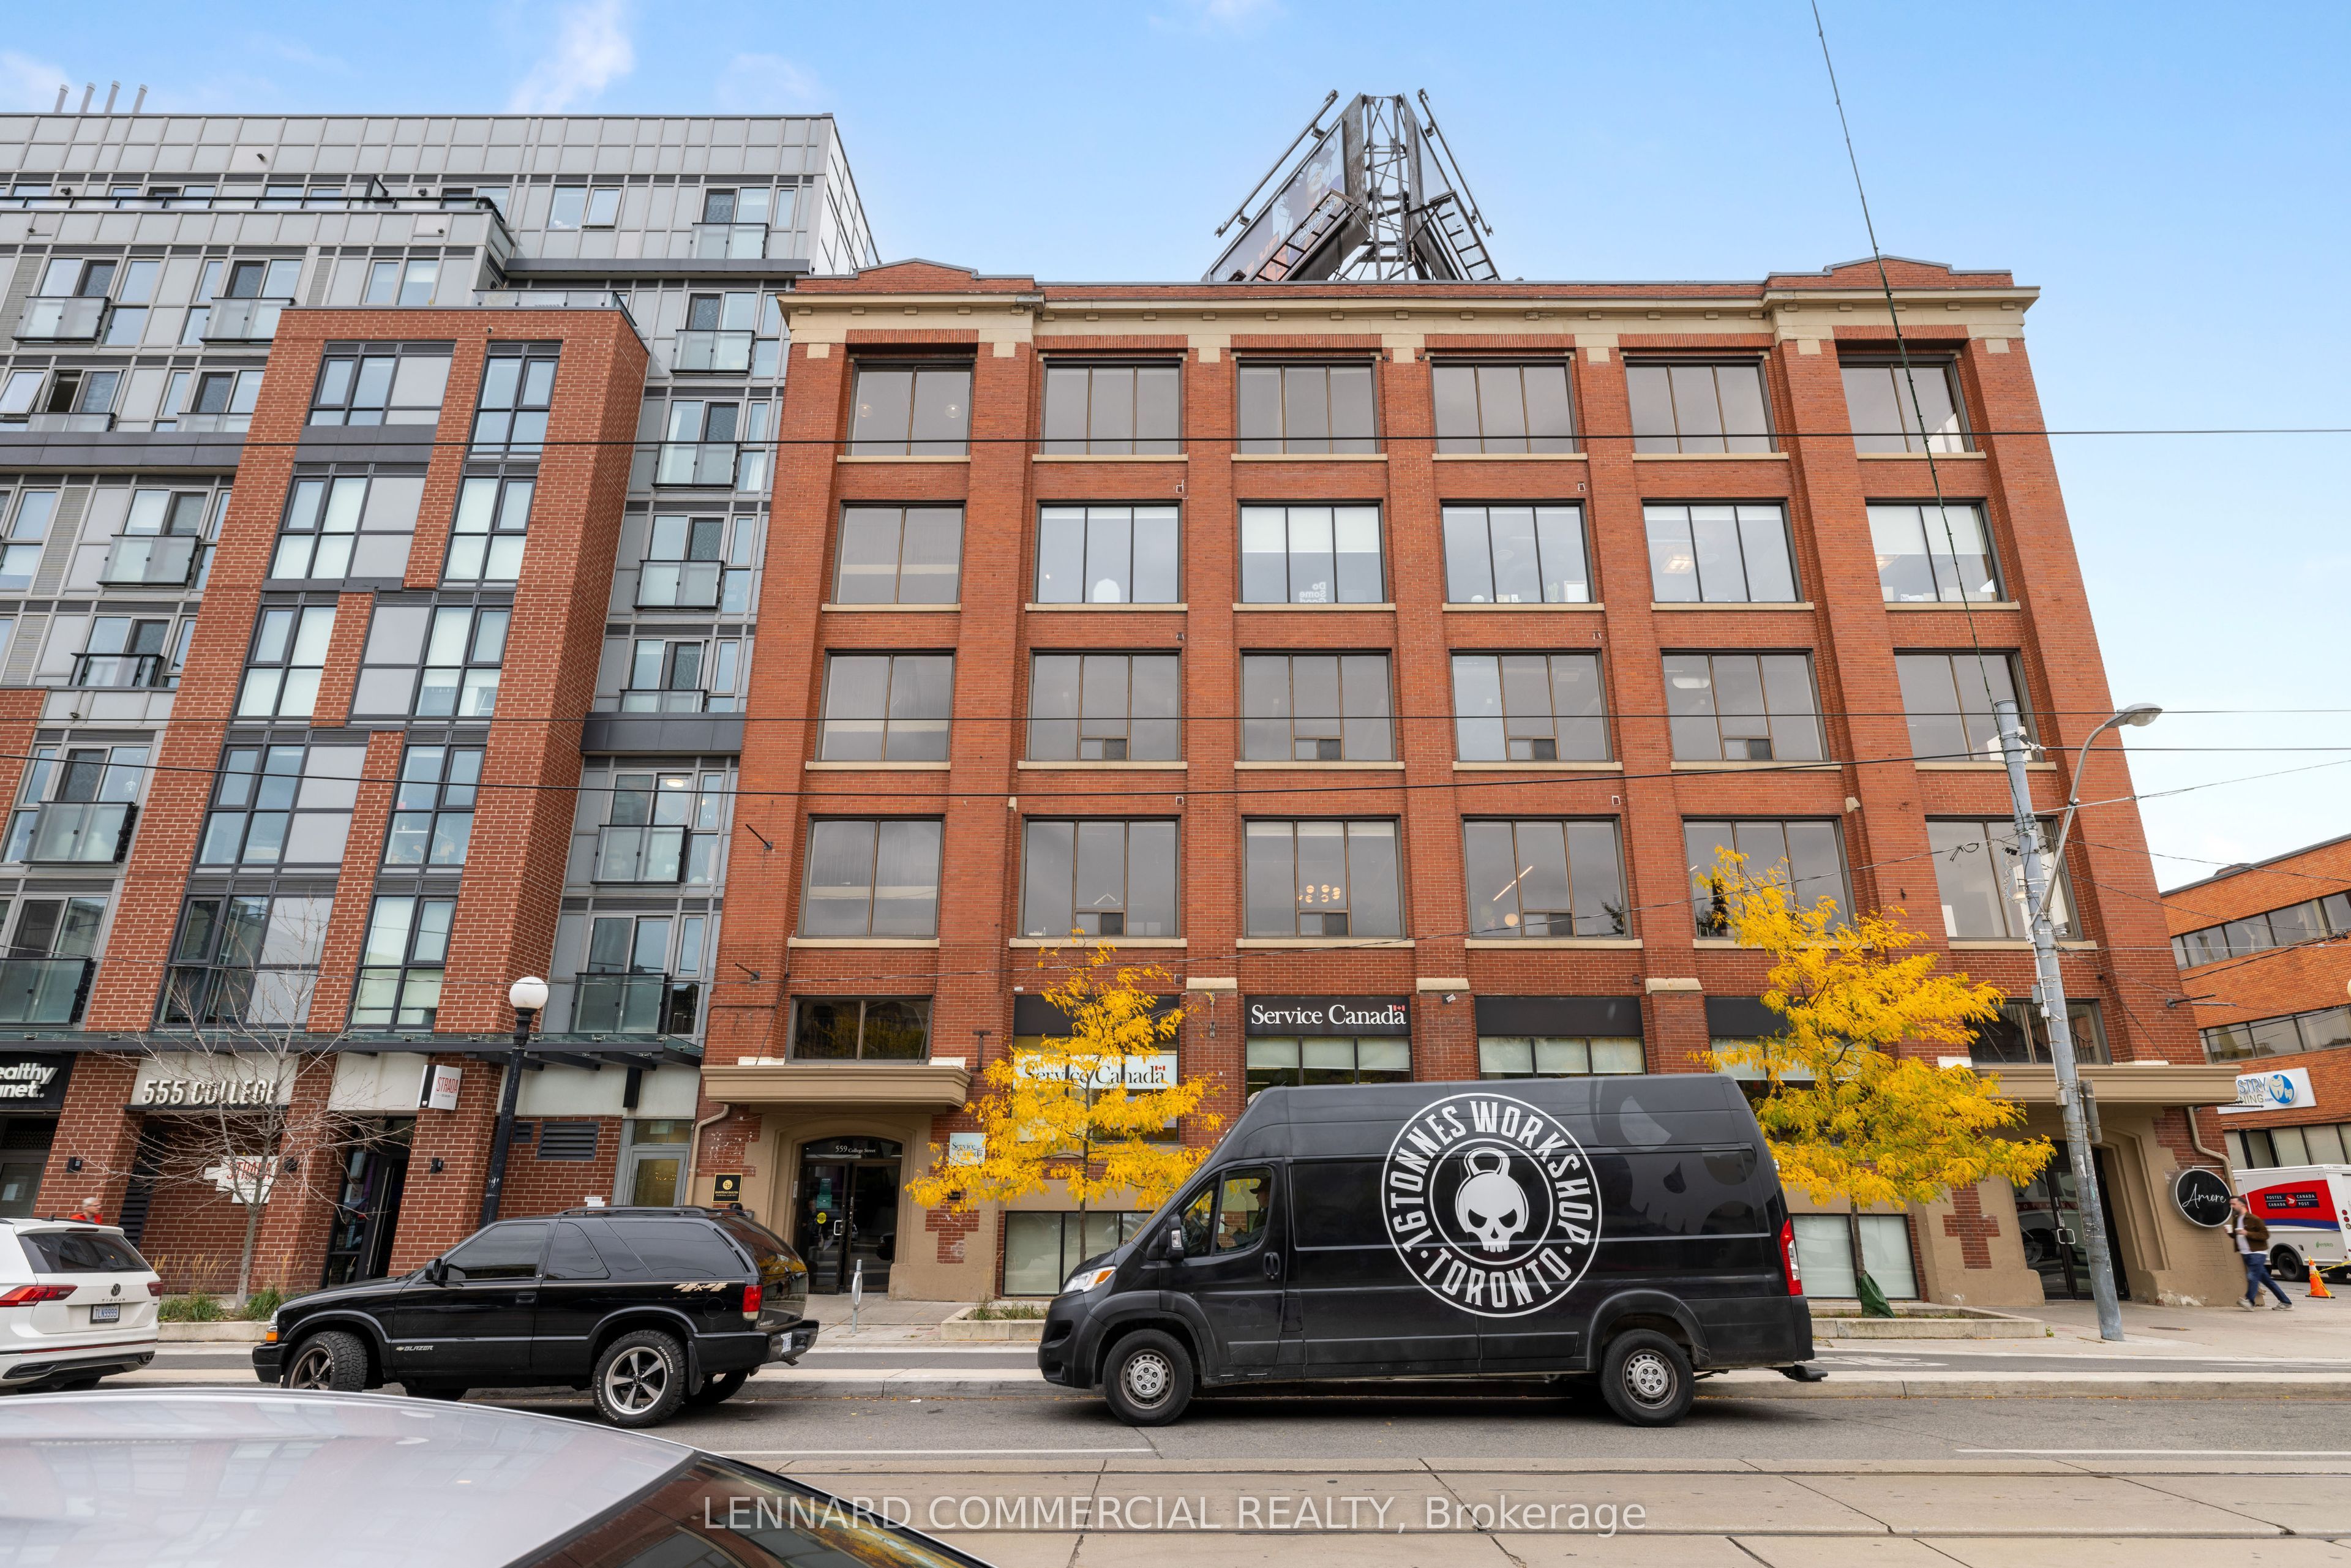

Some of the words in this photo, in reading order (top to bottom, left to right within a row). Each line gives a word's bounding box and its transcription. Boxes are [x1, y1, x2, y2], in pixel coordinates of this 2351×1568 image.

[1297, 202, 1333, 242] PATTISON
[1251, 1005, 1322, 1024] Service
[1329, 1005, 1406, 1025] Canada
[1025, 1065, 1089, 1084] Servce
[141, 1079, 186, 1105] 555
[437, 1077, 459, 1093] STRADA
[2238, 1078, 2268, 1093] STRY
[2182, 1183, 2226, 1209] Amore
[673, 1283, 728, 1292] 4x4
[1423, 1247, 1572, 1308] TORONTO
[95, 1308, 118, 1318] TLN9999
[658, 1346, 673, 1374] POWERHUB
